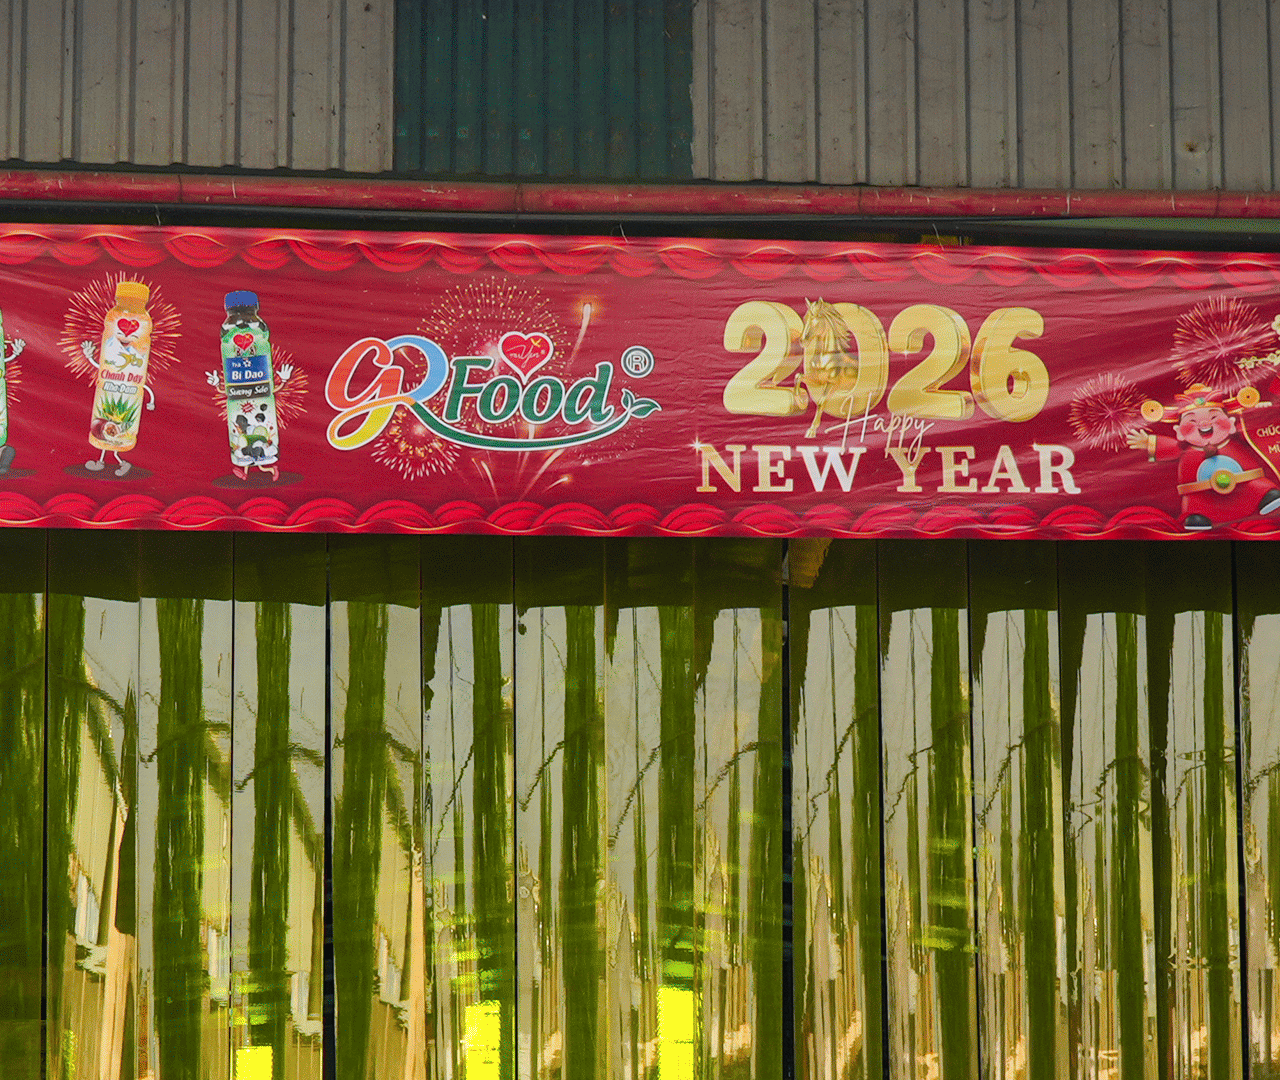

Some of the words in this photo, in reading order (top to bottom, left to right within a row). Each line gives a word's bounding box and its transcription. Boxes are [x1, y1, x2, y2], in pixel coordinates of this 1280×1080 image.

[100, 369, 125, 381] Chanh
[723, 300, 1050, 422] 2026
[824, 391, 934, 464] Happy
[696, 443, 868, 493] NEW
[888, 444, 1081, 494] YEAR
